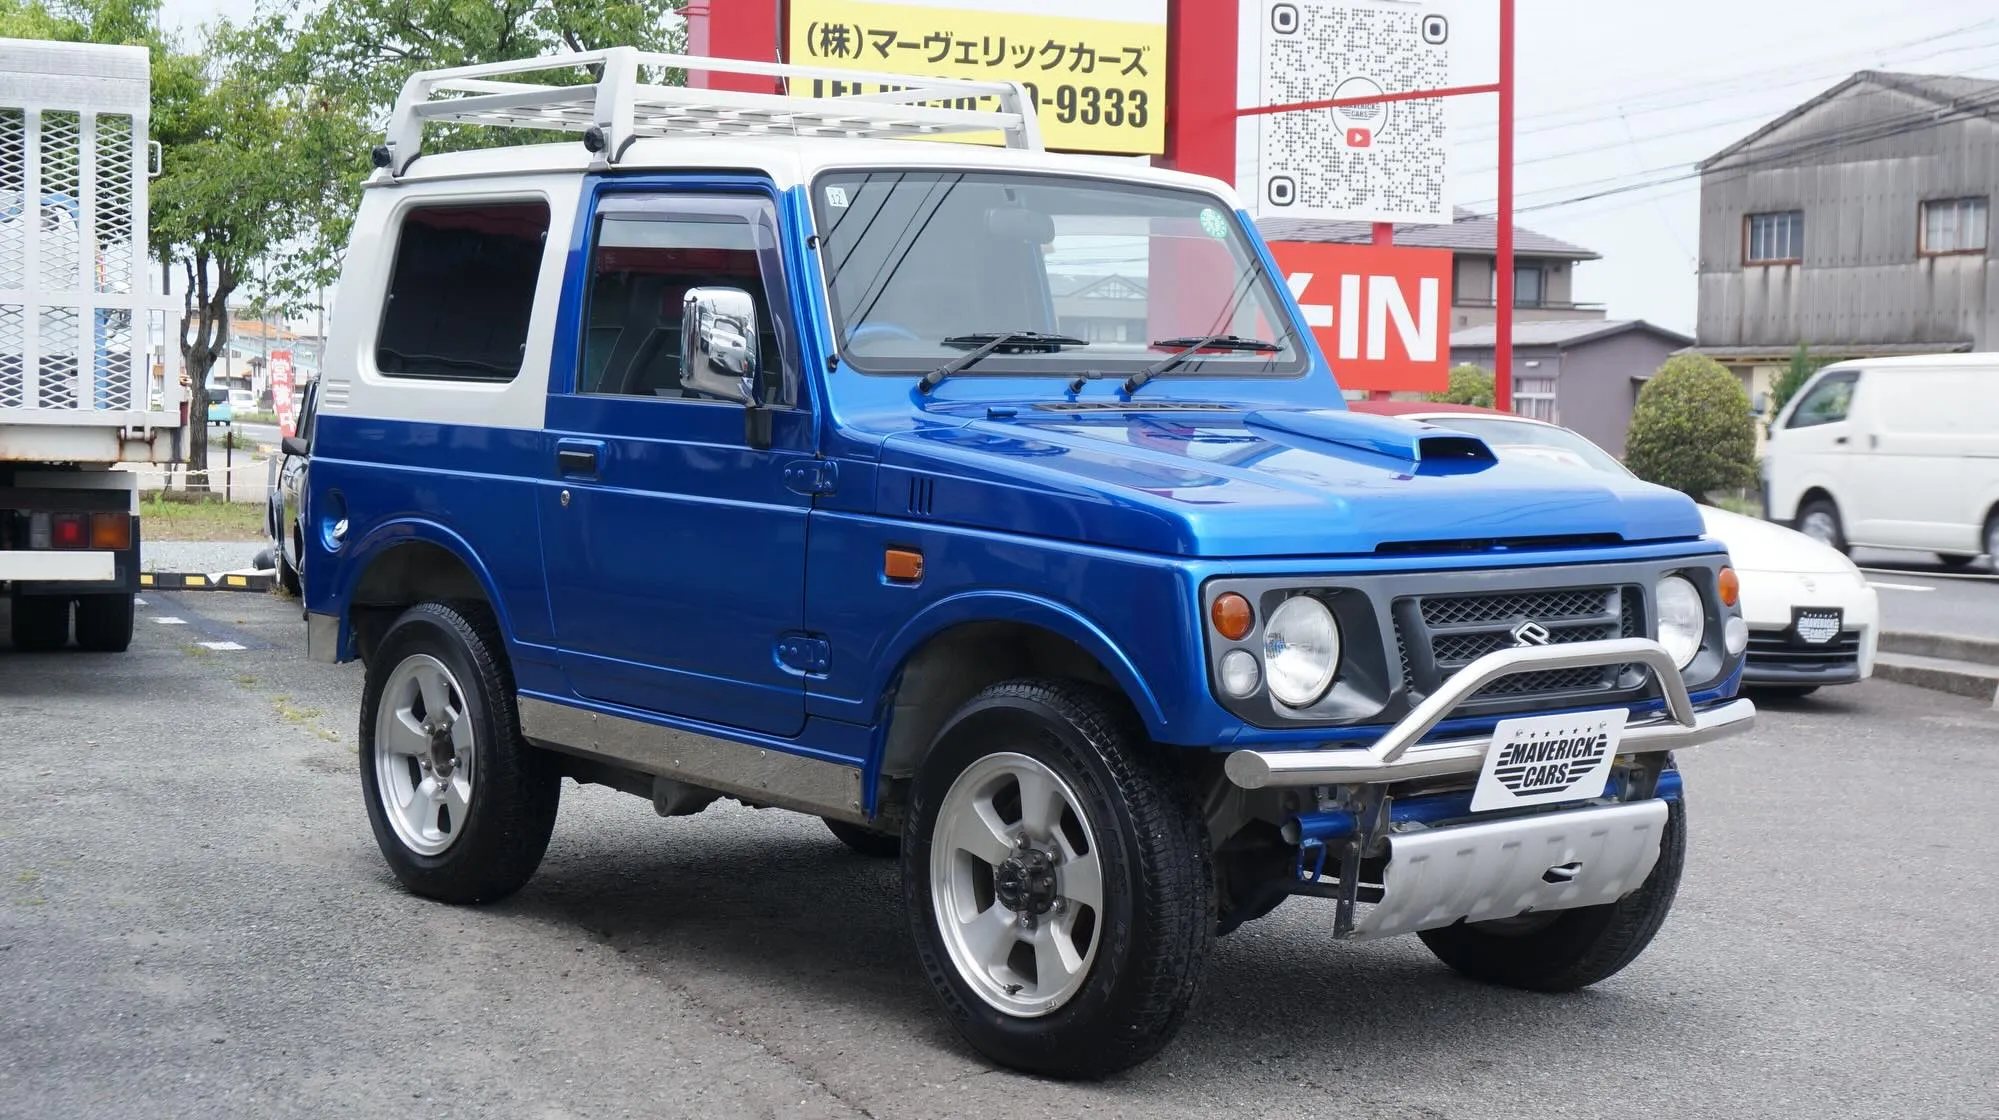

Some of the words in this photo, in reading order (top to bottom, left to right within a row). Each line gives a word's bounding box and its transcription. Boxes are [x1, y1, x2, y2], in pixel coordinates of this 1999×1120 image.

[807, 22, 1150, 77] (株)マーヴェリックカーズ
[1509, 735, 1598, 765] MAVERICK
[1522, 763, 1569, 788] CARS
